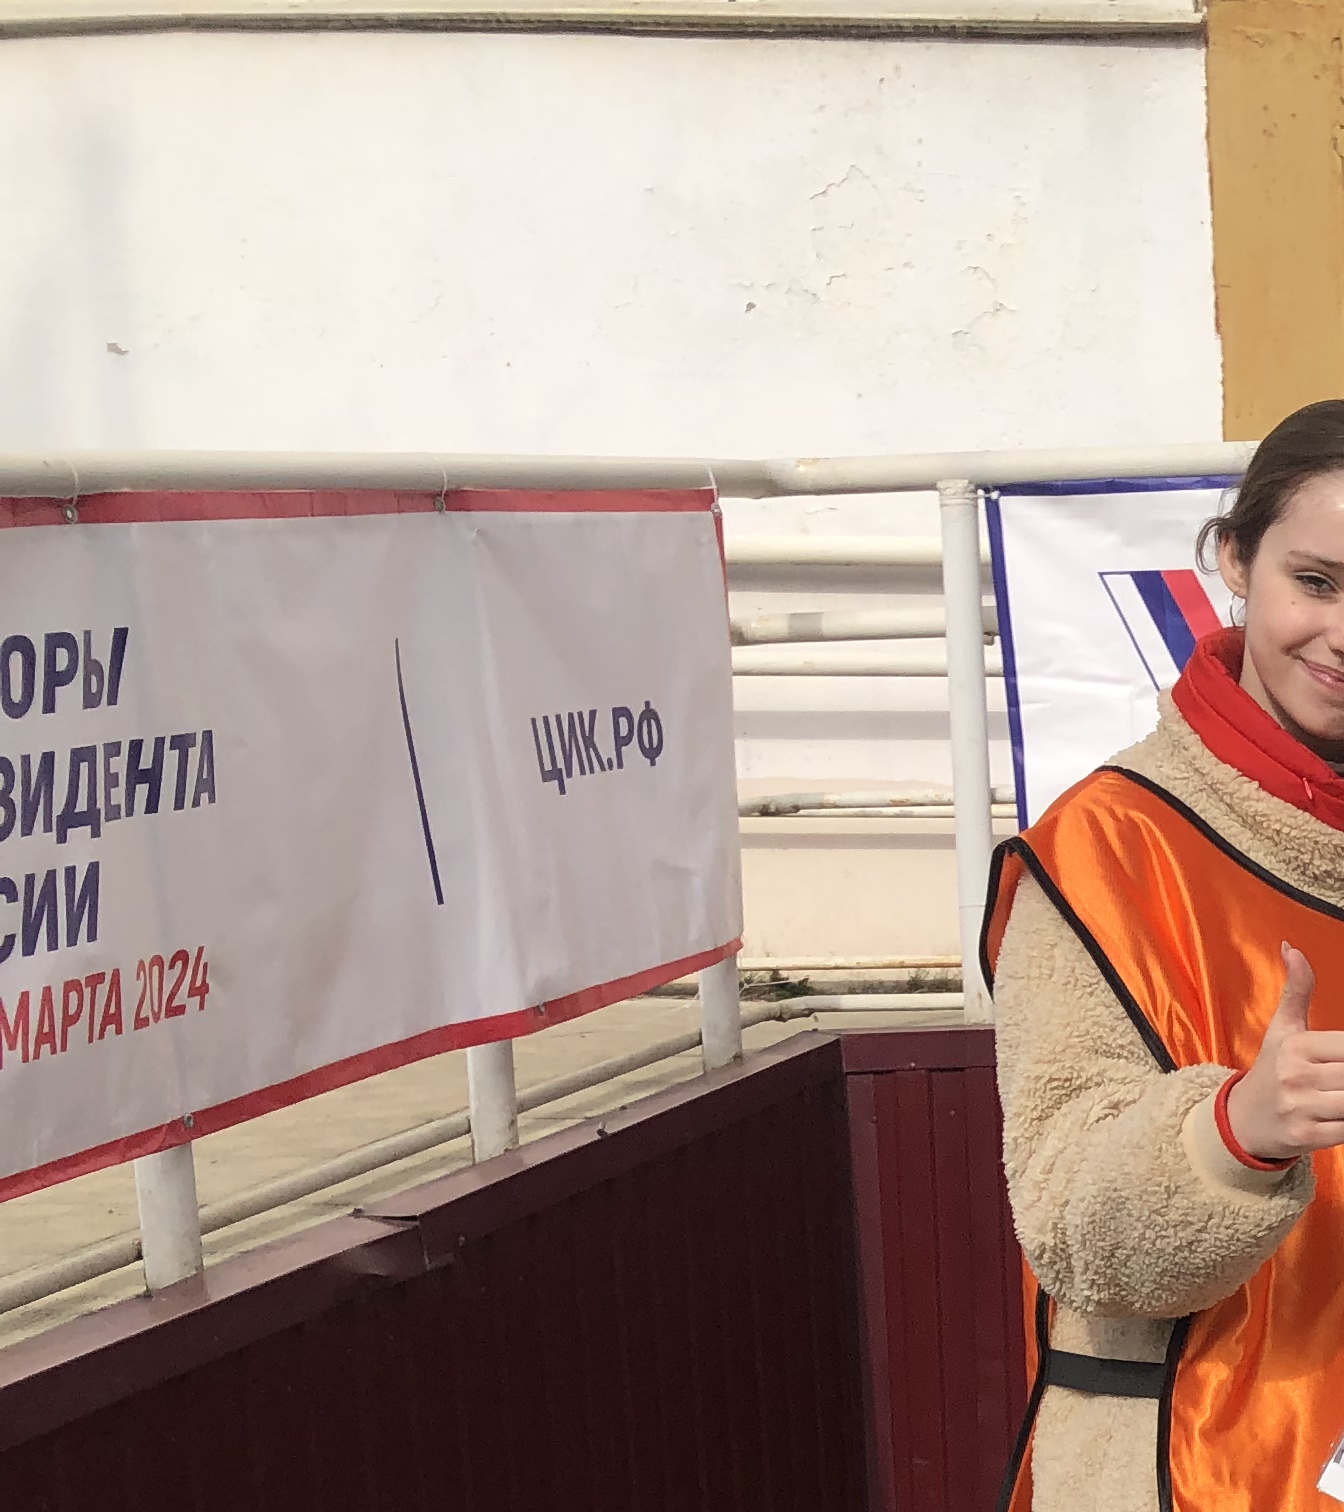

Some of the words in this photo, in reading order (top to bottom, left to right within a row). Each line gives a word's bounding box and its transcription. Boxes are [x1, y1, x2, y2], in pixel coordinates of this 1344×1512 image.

[0, 627, 129, 719] ОРЫ
[530, 700, 664, 796] ЦИК.РФ
[0, 967, 123, 1072] МАРТА
[133, 945, 210, 1032] 2024
